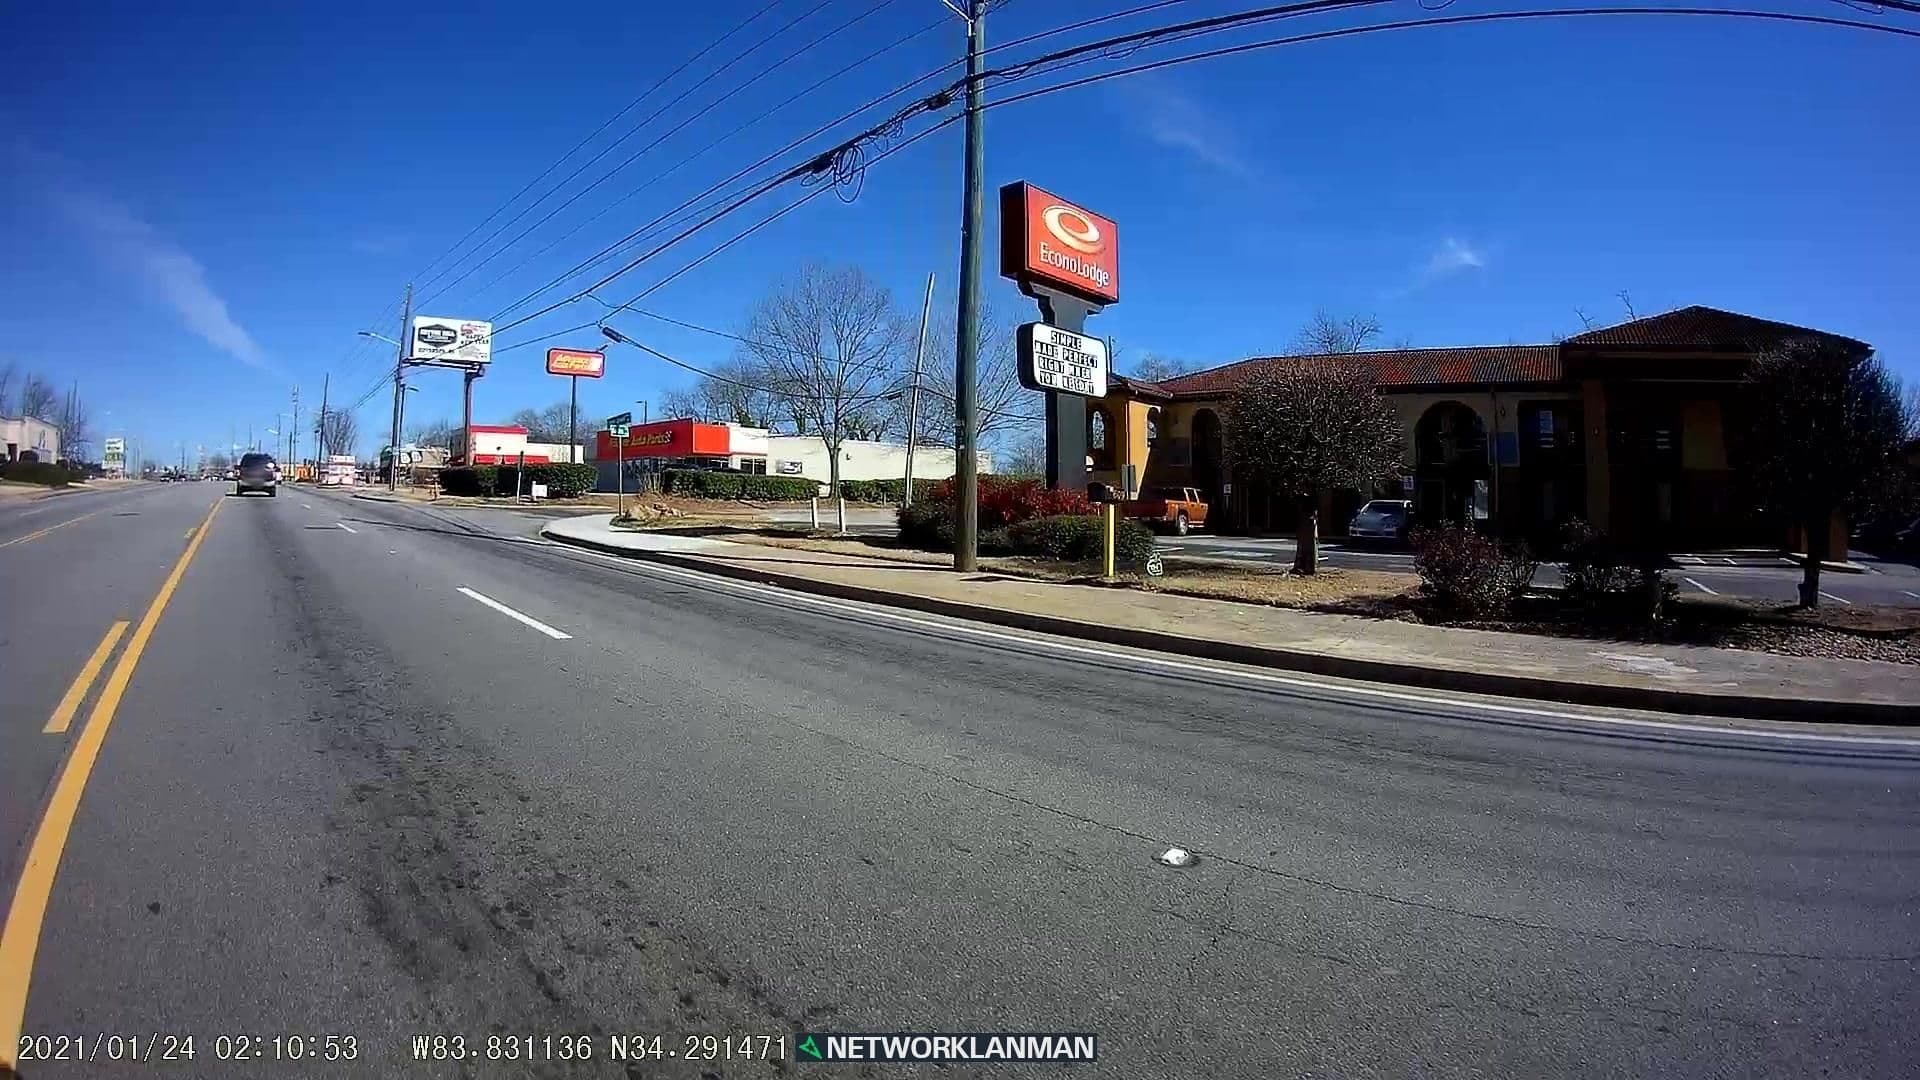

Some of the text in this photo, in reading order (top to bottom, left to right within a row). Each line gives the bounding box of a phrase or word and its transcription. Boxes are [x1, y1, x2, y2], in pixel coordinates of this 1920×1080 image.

[1051, 331, 1081, 350] SIMPLE
[1035, 340, 1097, 368] MADE PERFECT
[1039, 355, 1064, 373] RIGHT
[1040, 371, 1057, 386] YOU
